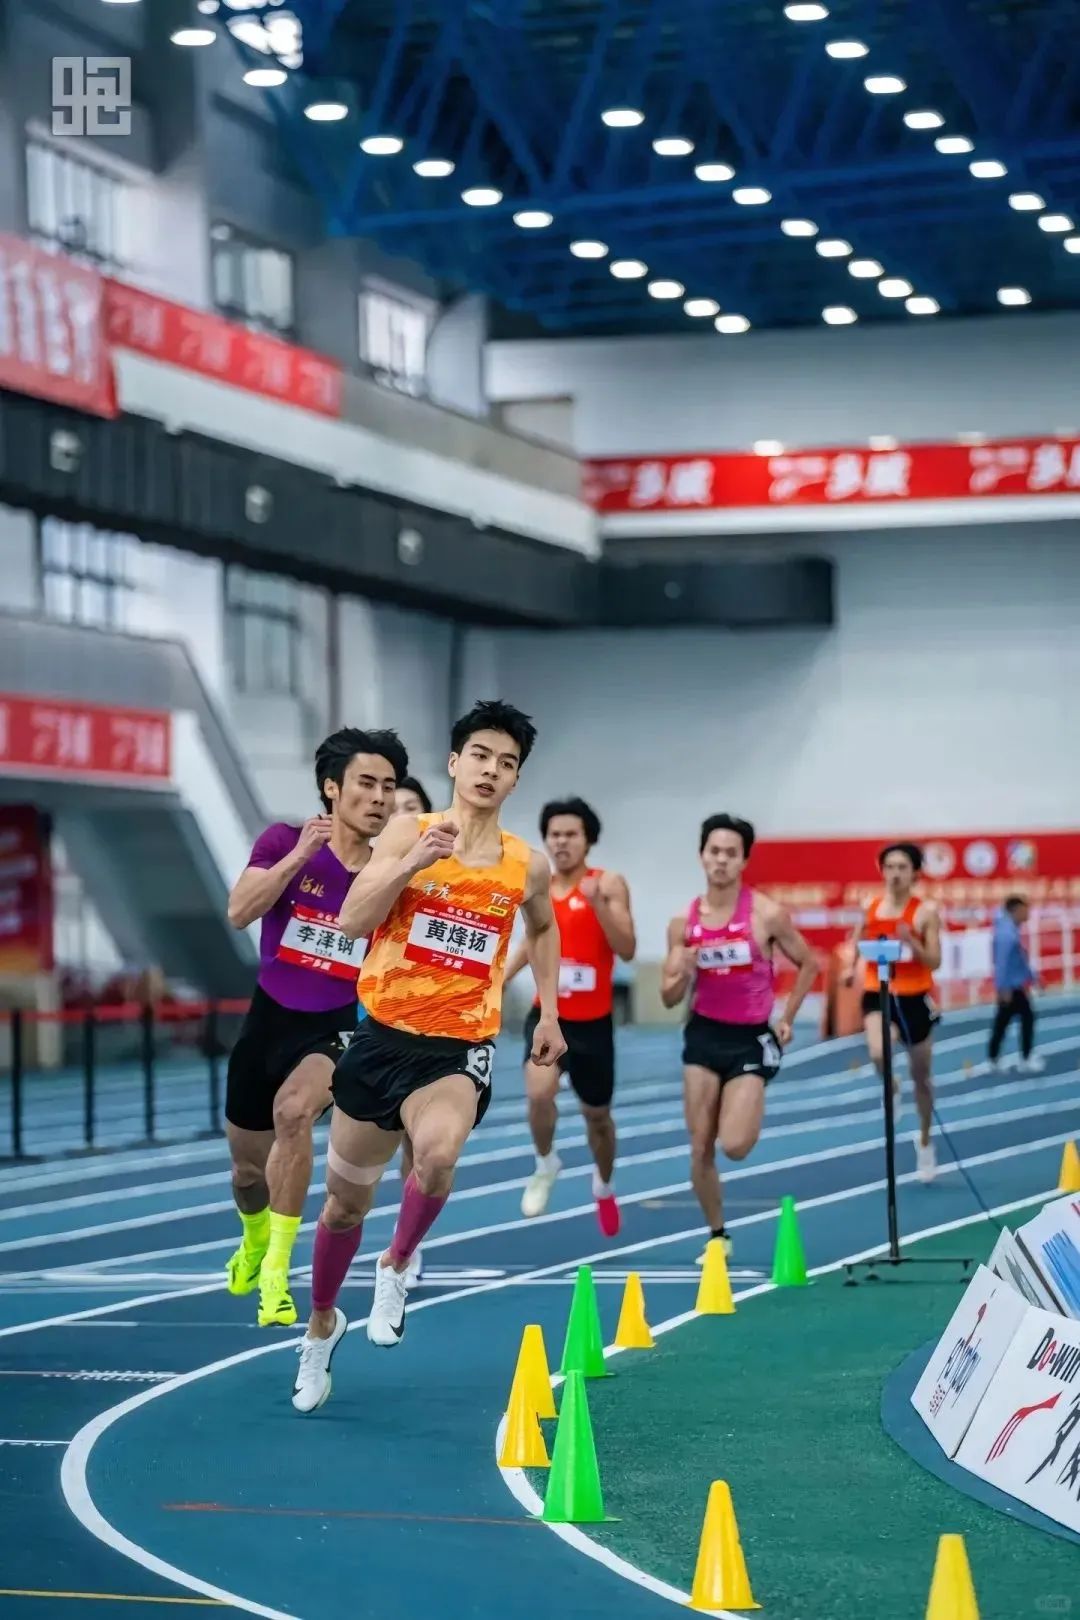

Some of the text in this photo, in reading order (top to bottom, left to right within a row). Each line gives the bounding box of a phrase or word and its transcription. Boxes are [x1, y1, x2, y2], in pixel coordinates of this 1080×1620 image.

[296, 925, 355, 956] 李泽钢
[425, 919, 489, 953] 黄烽扬
[445, 945, 465, 956] 1061
[472, 1046, 490, 1078] 3
